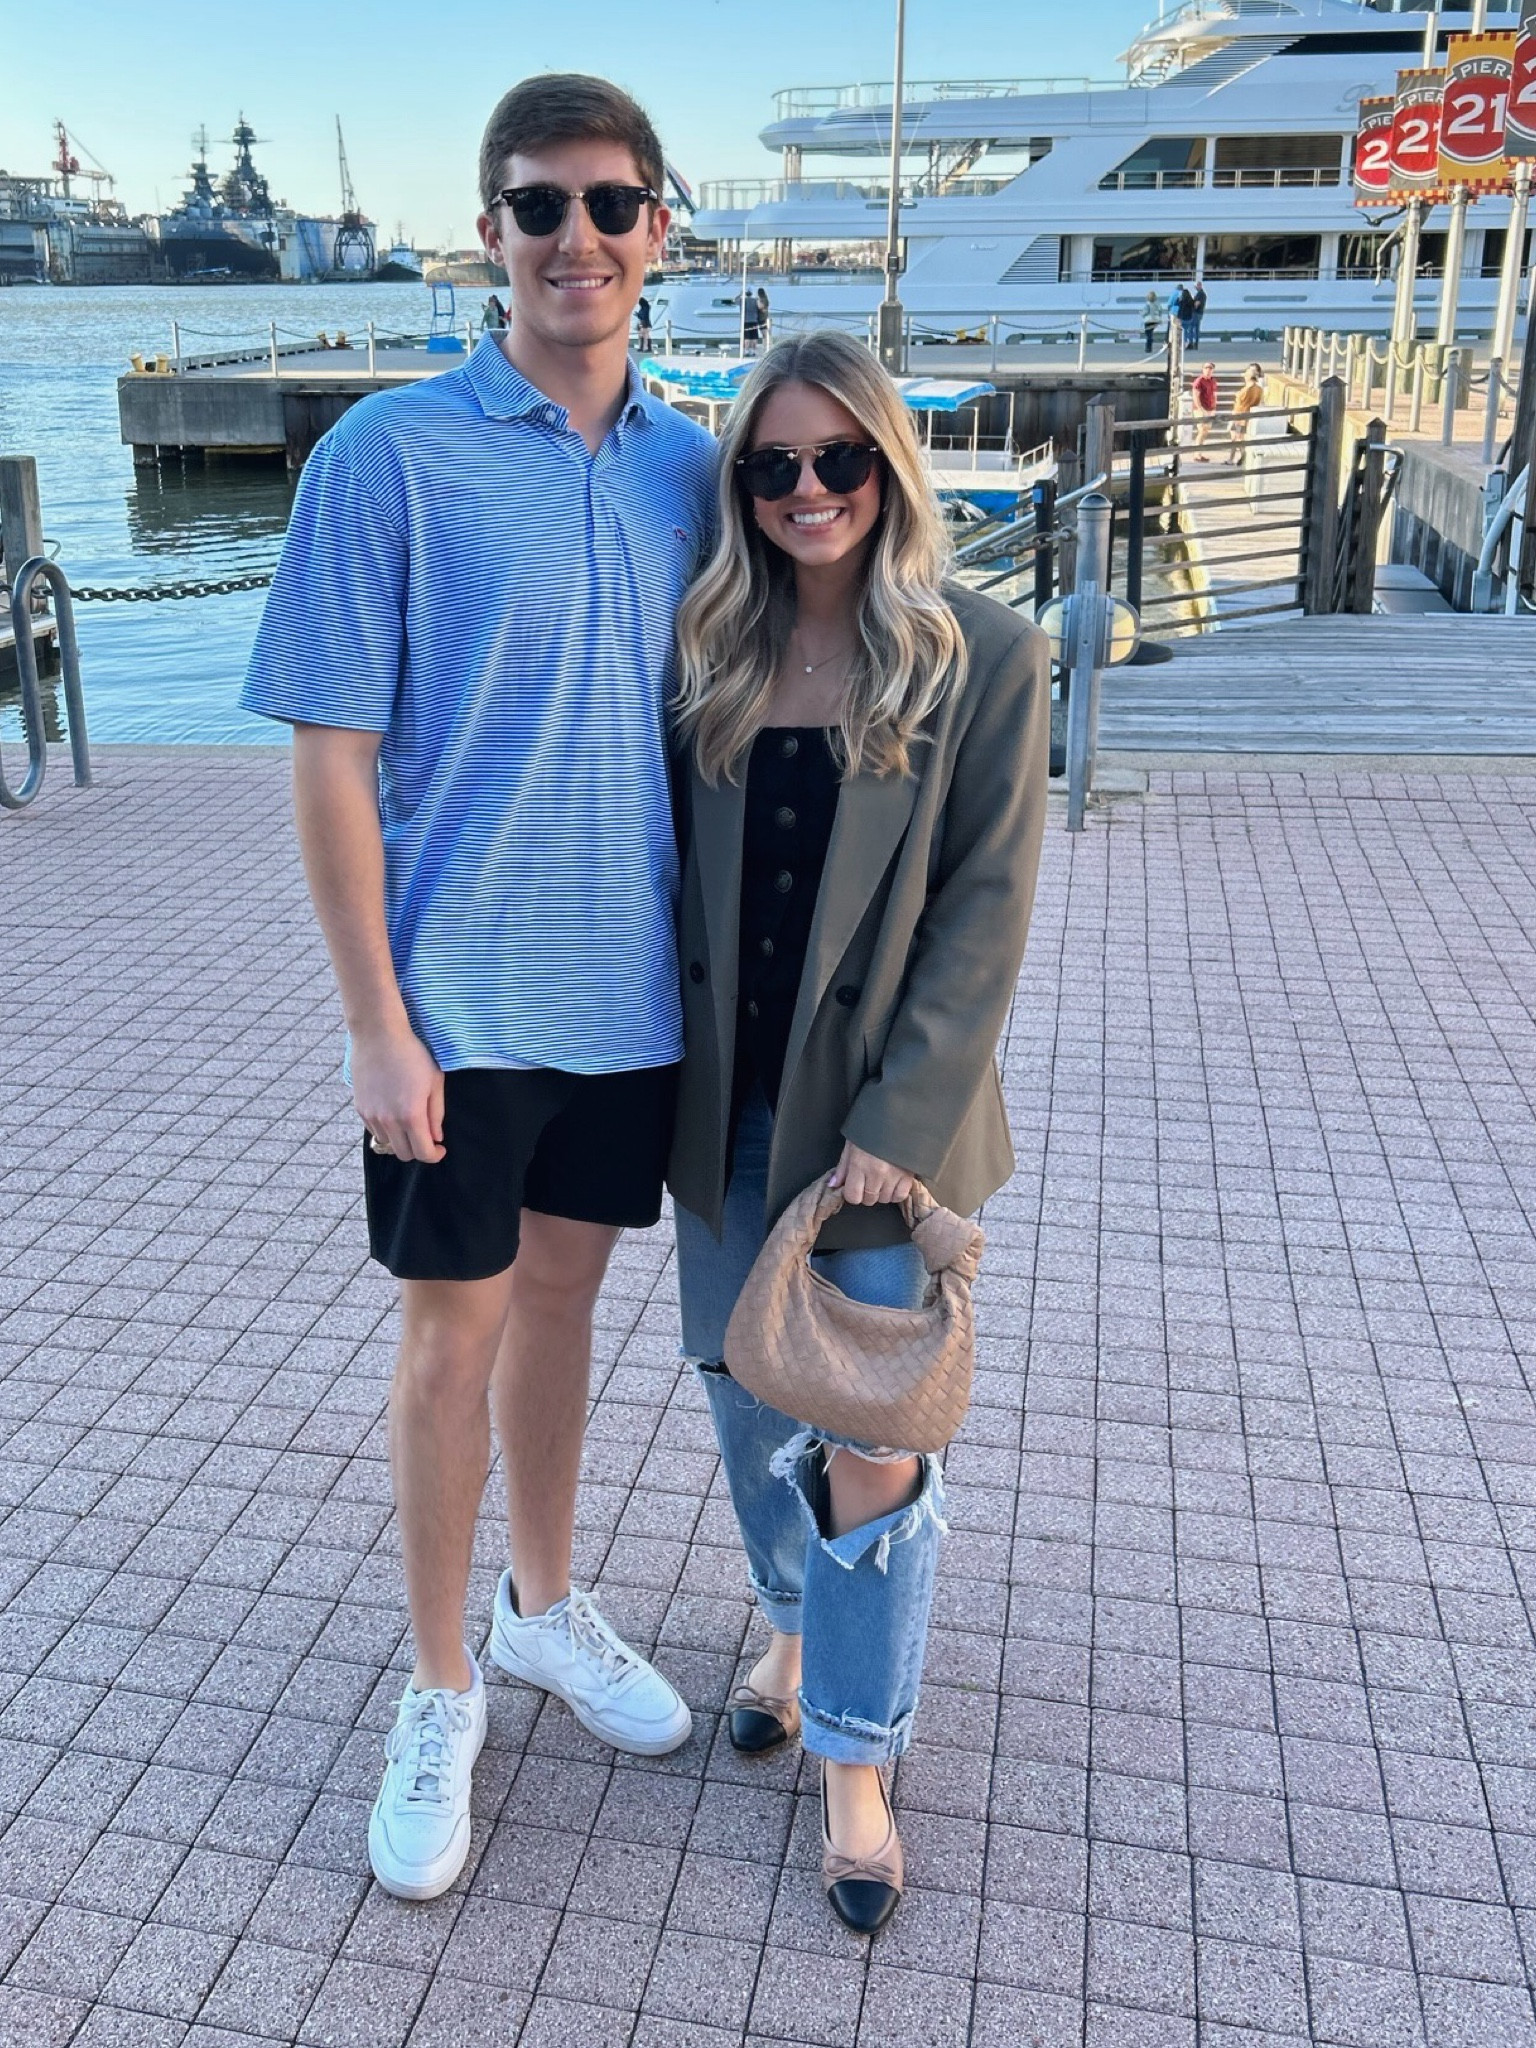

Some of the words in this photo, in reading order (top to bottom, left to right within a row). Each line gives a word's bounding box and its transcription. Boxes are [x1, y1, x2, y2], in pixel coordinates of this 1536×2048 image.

[1460, 61, 1507, 78] PIER
[1367, 116, 1393, 129] PIE
[1447, 93, 1508, 136] 21
[1361, 139, 1390, 171] 2
